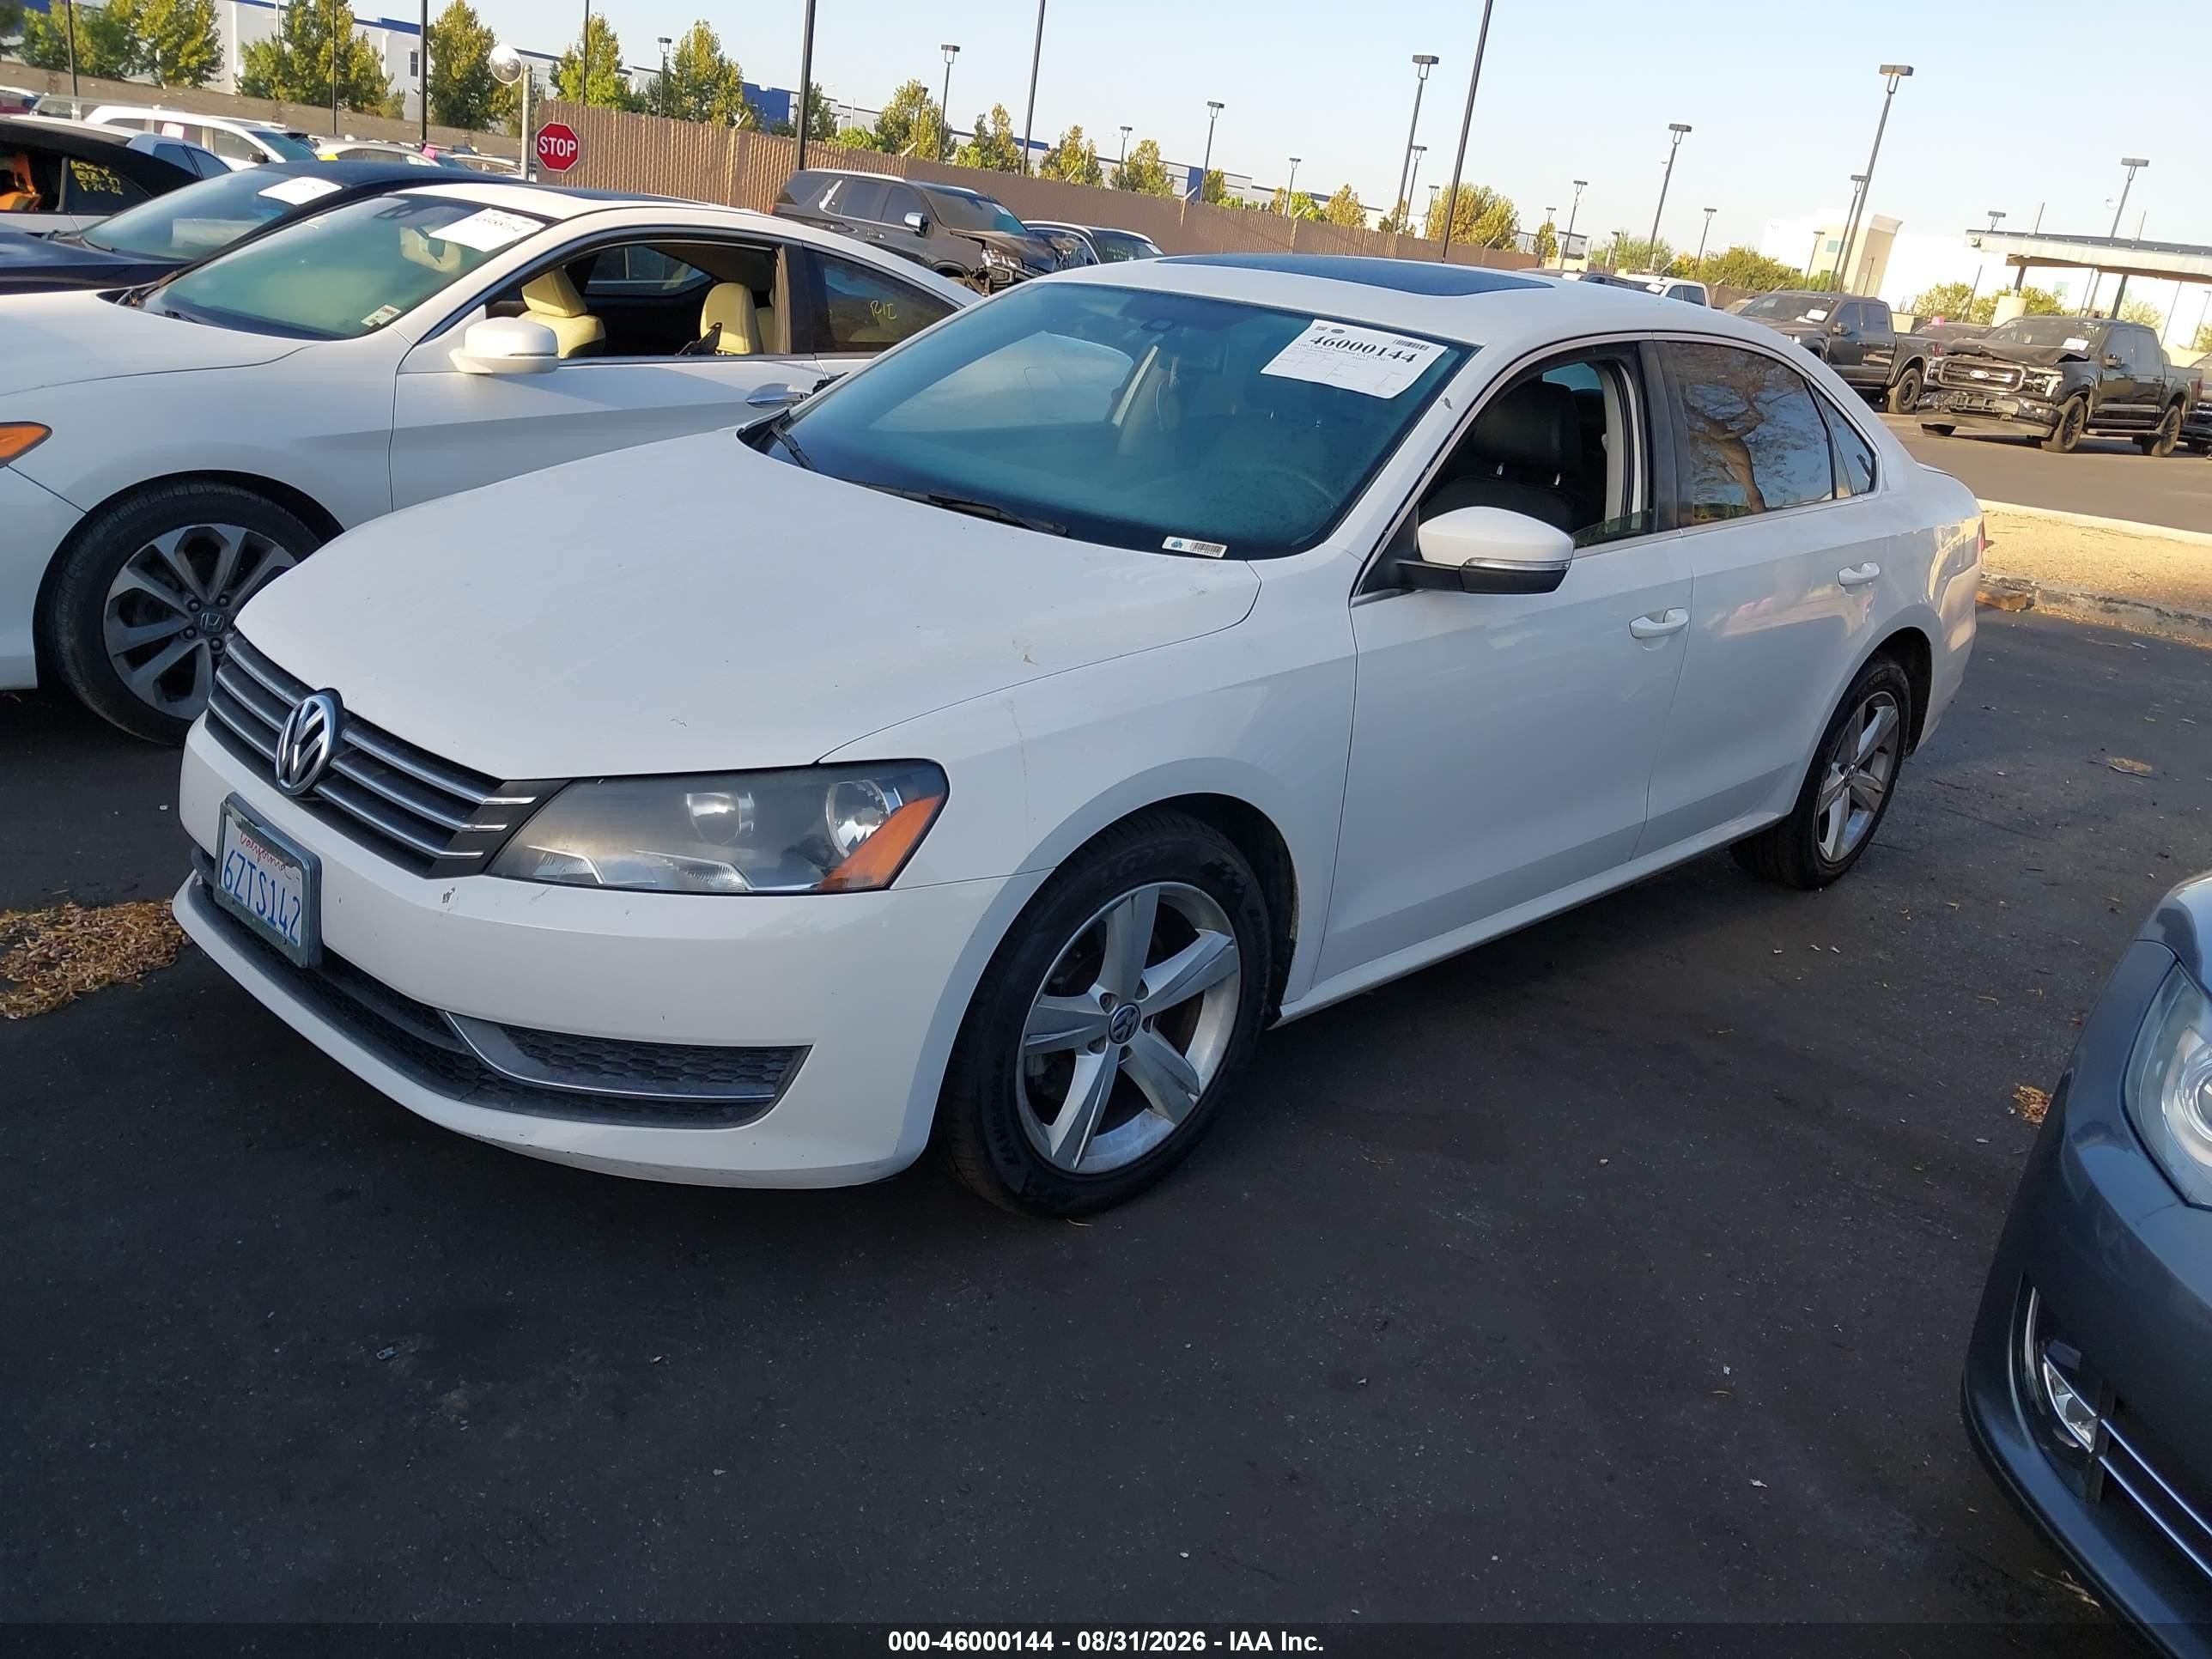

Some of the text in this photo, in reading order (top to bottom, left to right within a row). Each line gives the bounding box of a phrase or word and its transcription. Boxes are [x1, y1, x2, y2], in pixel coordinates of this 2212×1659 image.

[538, 136, 576, 157] STOP
[1310, 335, 1419, 363] 46000144
[223, 849, 301, 945] 6ZTS142
